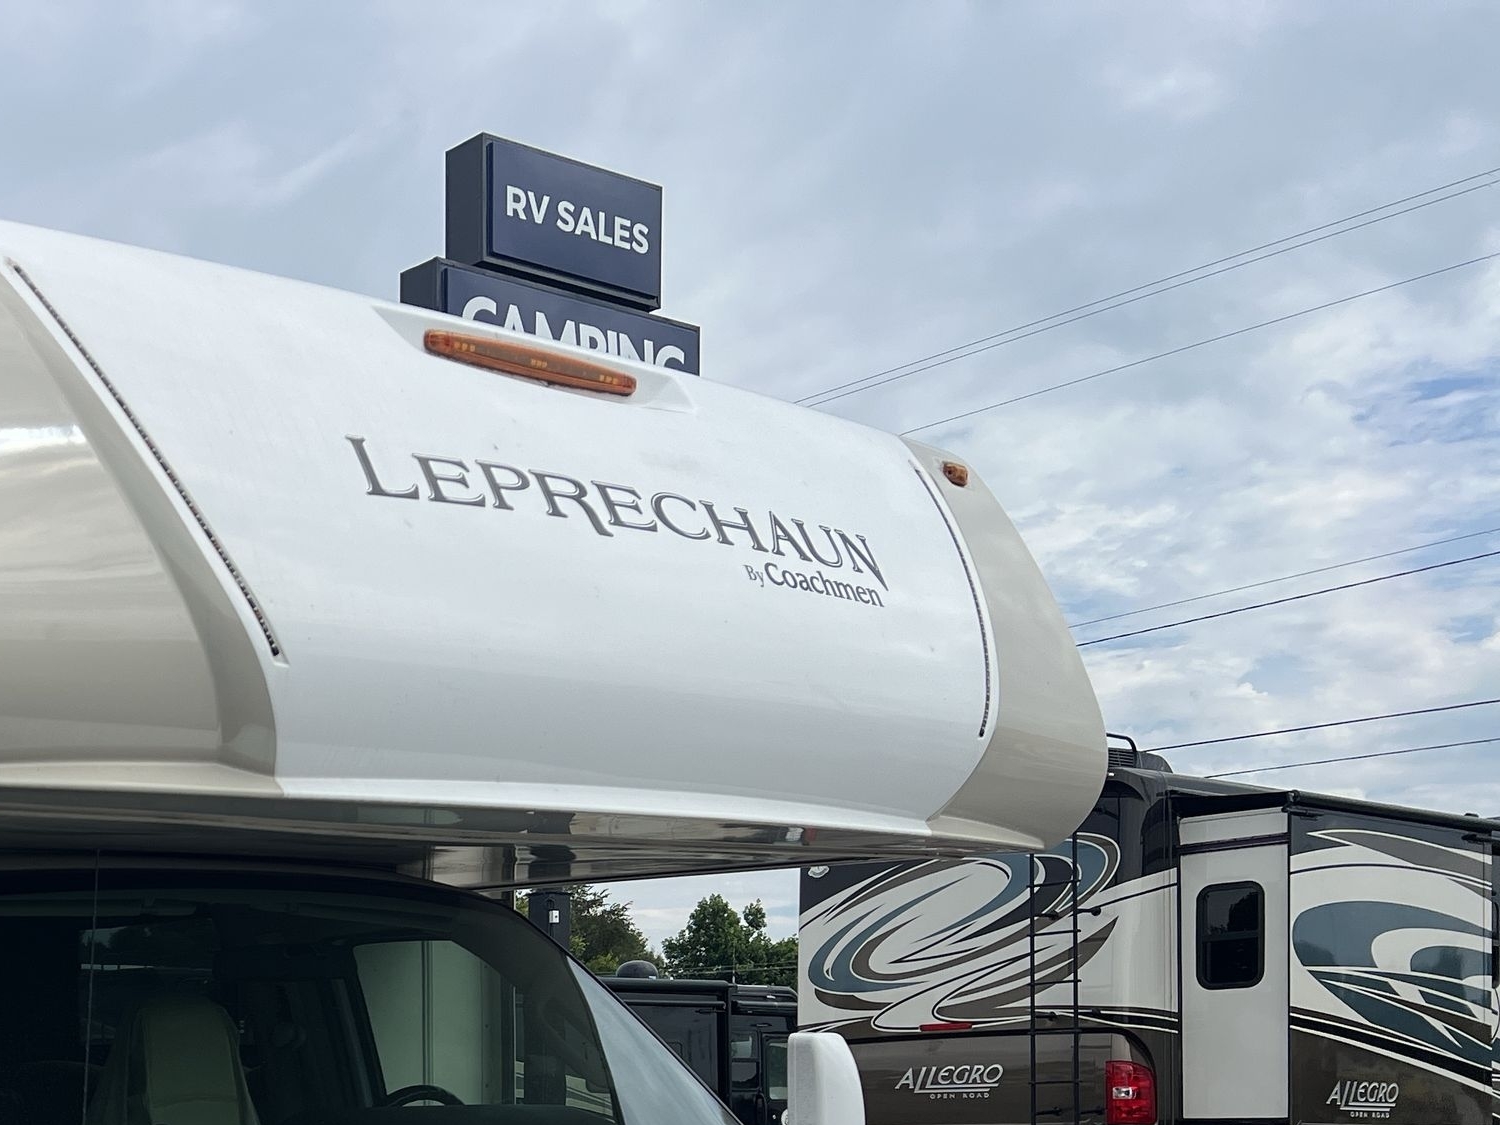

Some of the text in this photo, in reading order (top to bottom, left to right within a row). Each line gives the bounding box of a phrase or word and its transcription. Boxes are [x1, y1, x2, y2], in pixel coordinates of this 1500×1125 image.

[506, 184, 650, 254] RV SALES
[345, 434, 889, 592] LEPRECHAUN
[742, 562, 885, 607] By Coachmen
[894, 1063, 1004, 1093] ALLEGRO
[1325, 1080, 1399, 1111] ALLEGRO
